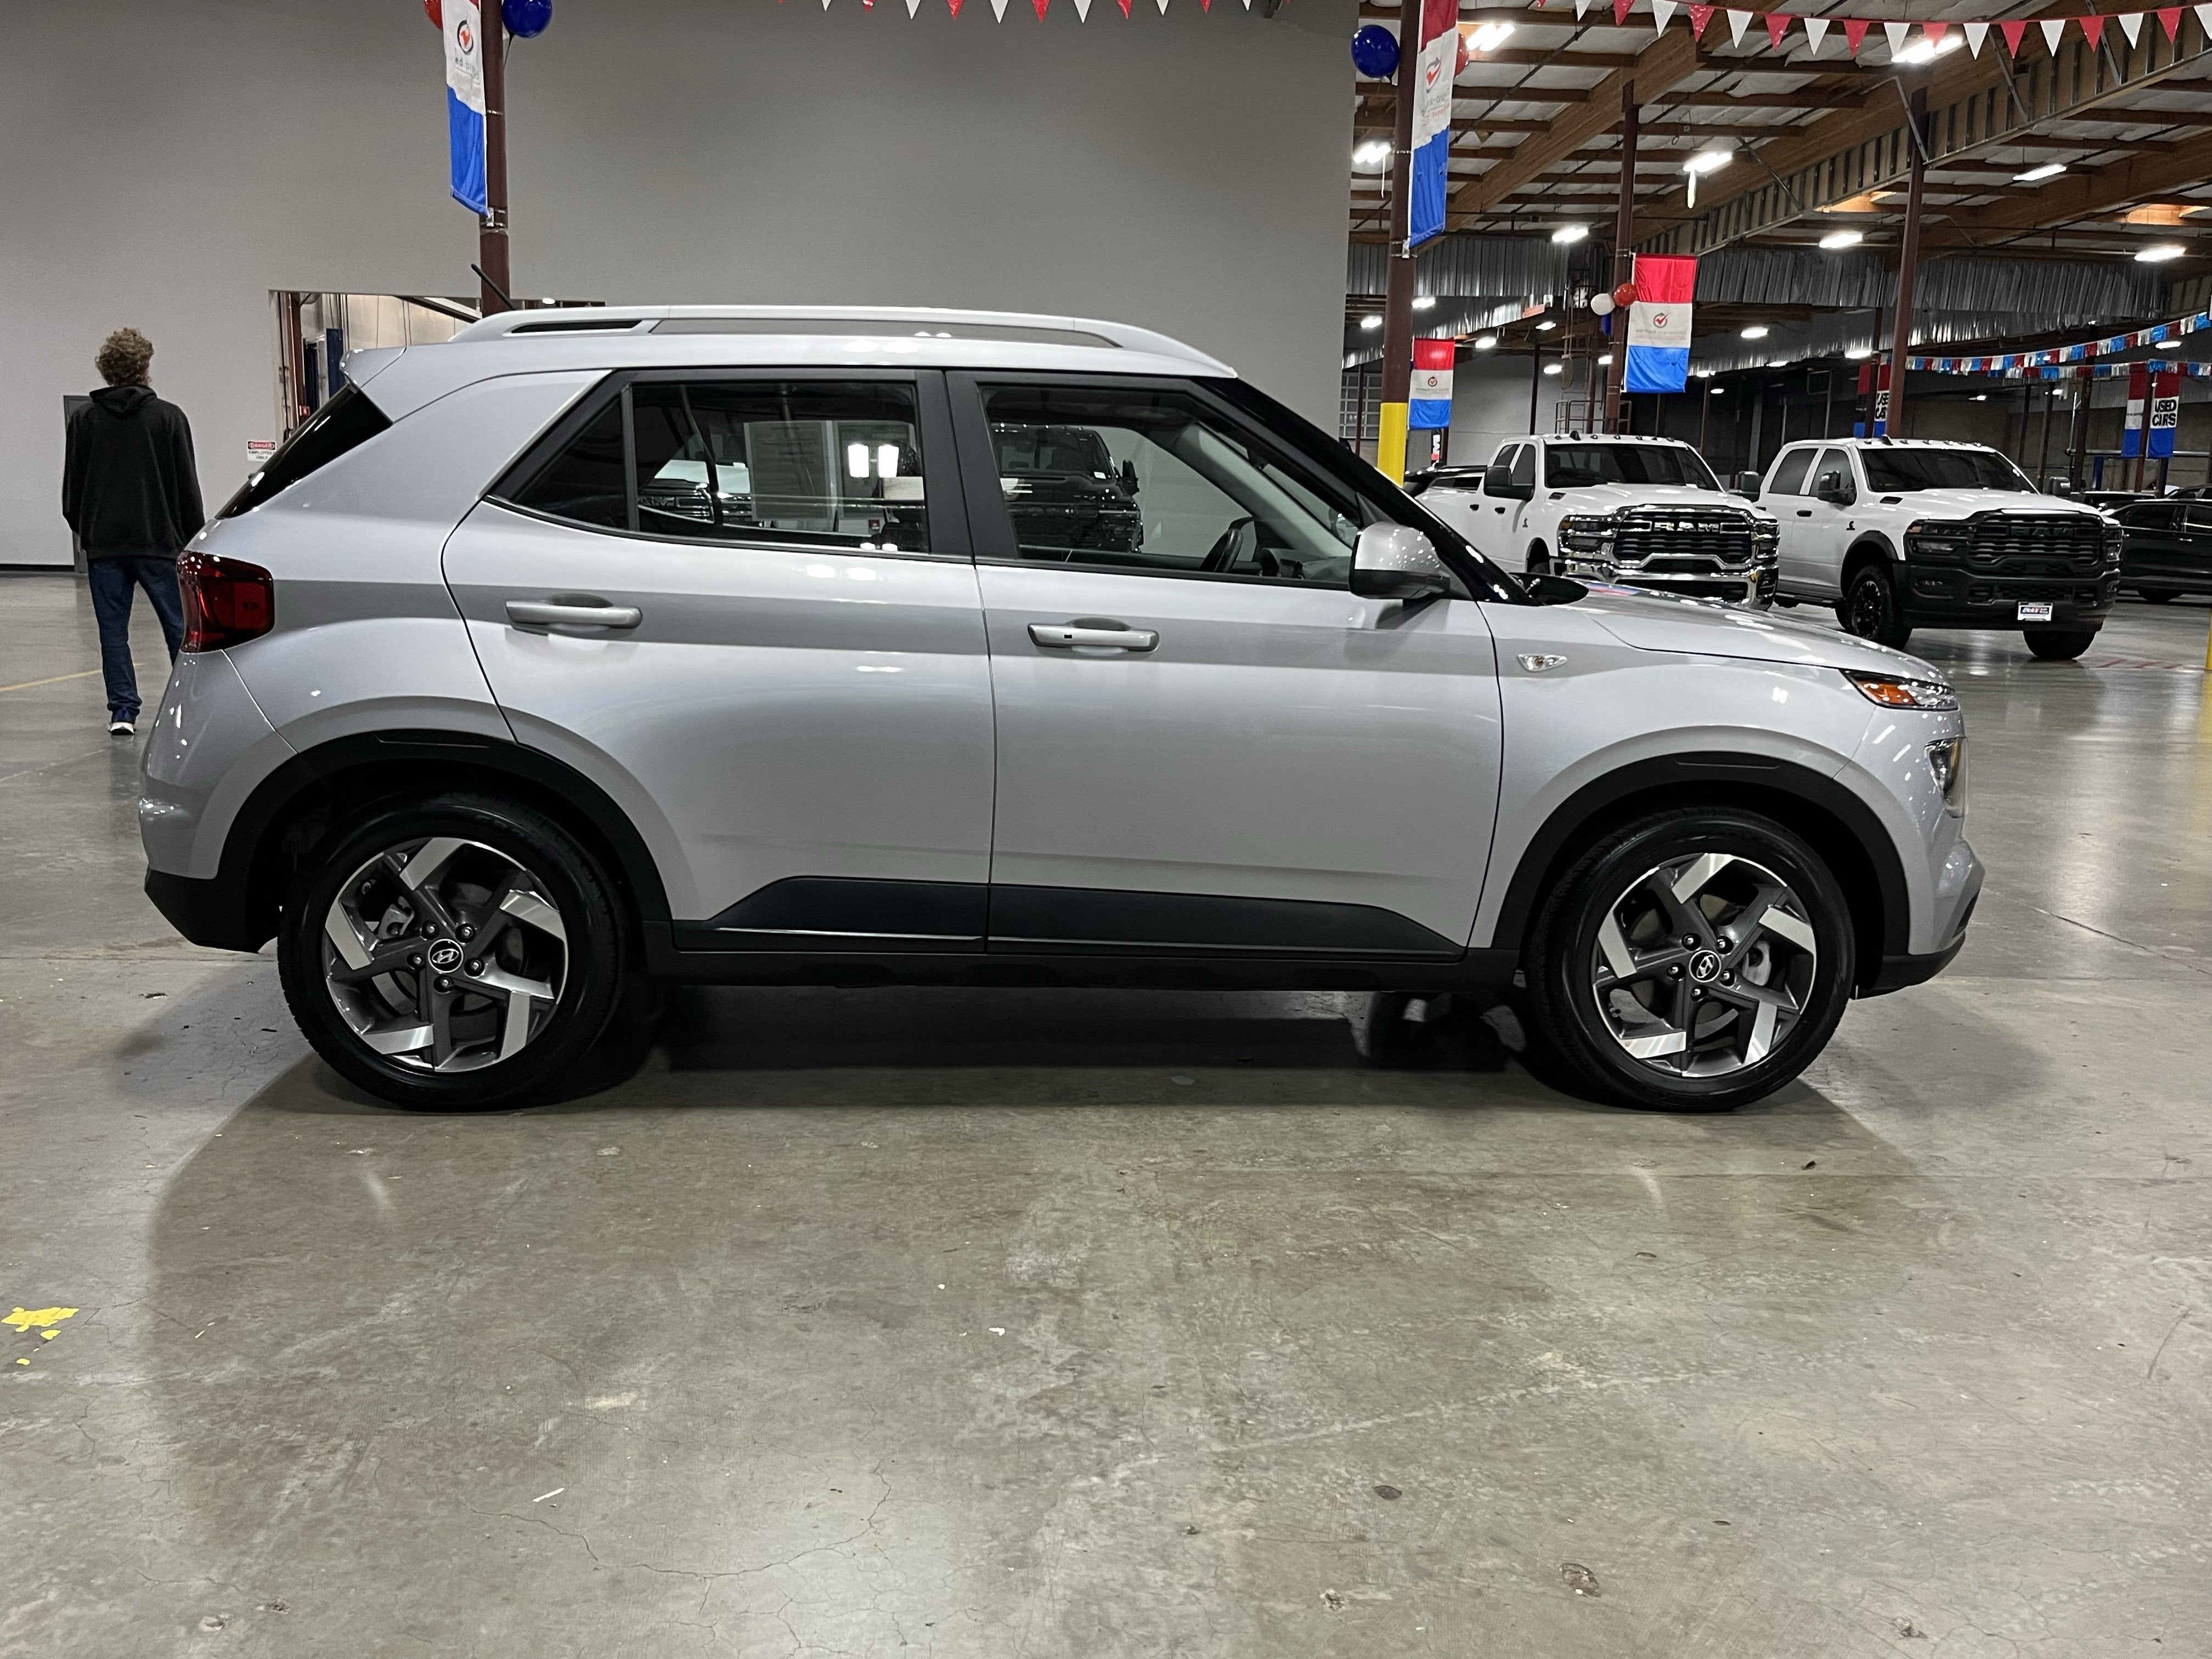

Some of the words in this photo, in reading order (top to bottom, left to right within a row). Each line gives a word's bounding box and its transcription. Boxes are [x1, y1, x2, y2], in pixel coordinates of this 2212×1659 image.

[2155, 400, 2176, 412] USED
[637, 496, 674, 506] AM
[1654, 522, 1719, 532] RAM
[2011, 526, 2073, 536] RAM
